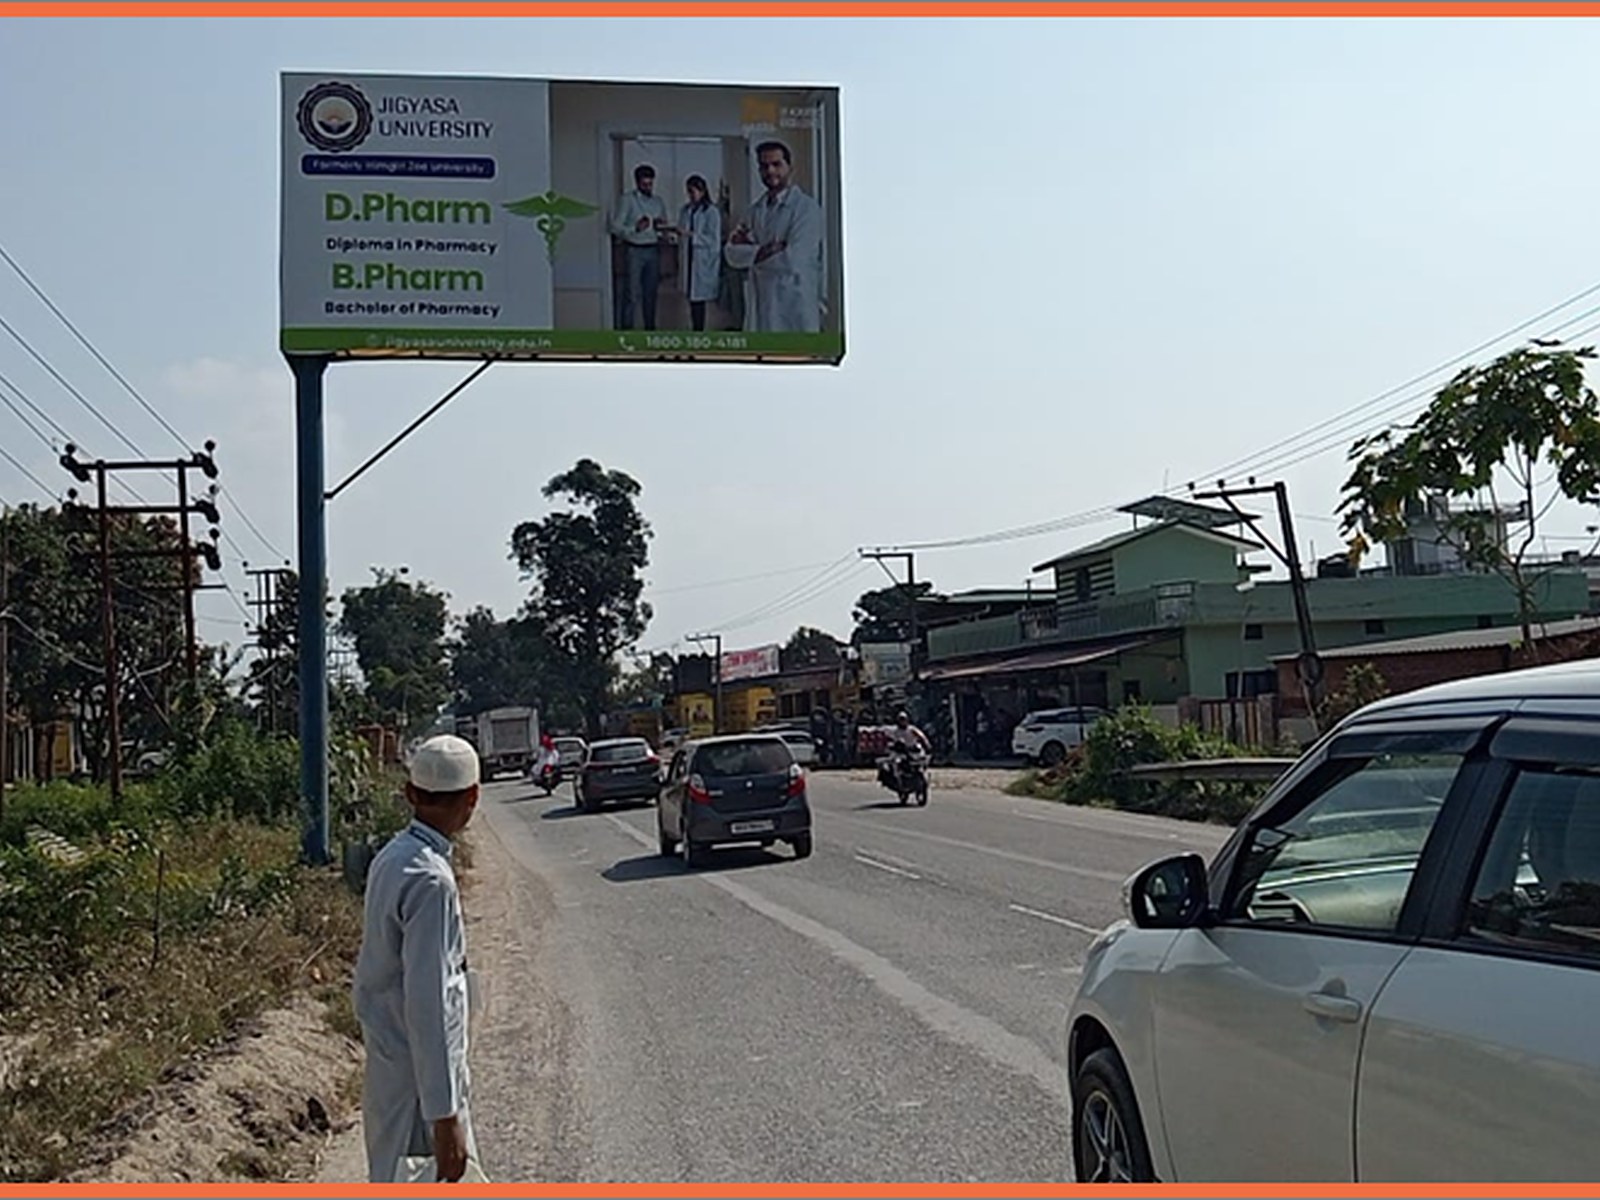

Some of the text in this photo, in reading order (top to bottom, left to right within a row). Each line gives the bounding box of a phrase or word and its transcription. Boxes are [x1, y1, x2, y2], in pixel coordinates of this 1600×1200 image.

[377, 96, 459, 115] JIGYASA
[378, 120, 493, 139] UNIVERSITY
[325, 192, 491, 224] D.Pharm
[326, 237, 498, 255] Diploma in Pharmacy
[332, 263, 484, 291] B.Pharm
[325, 302, 500, 318] Bachelor of Pharmacy
